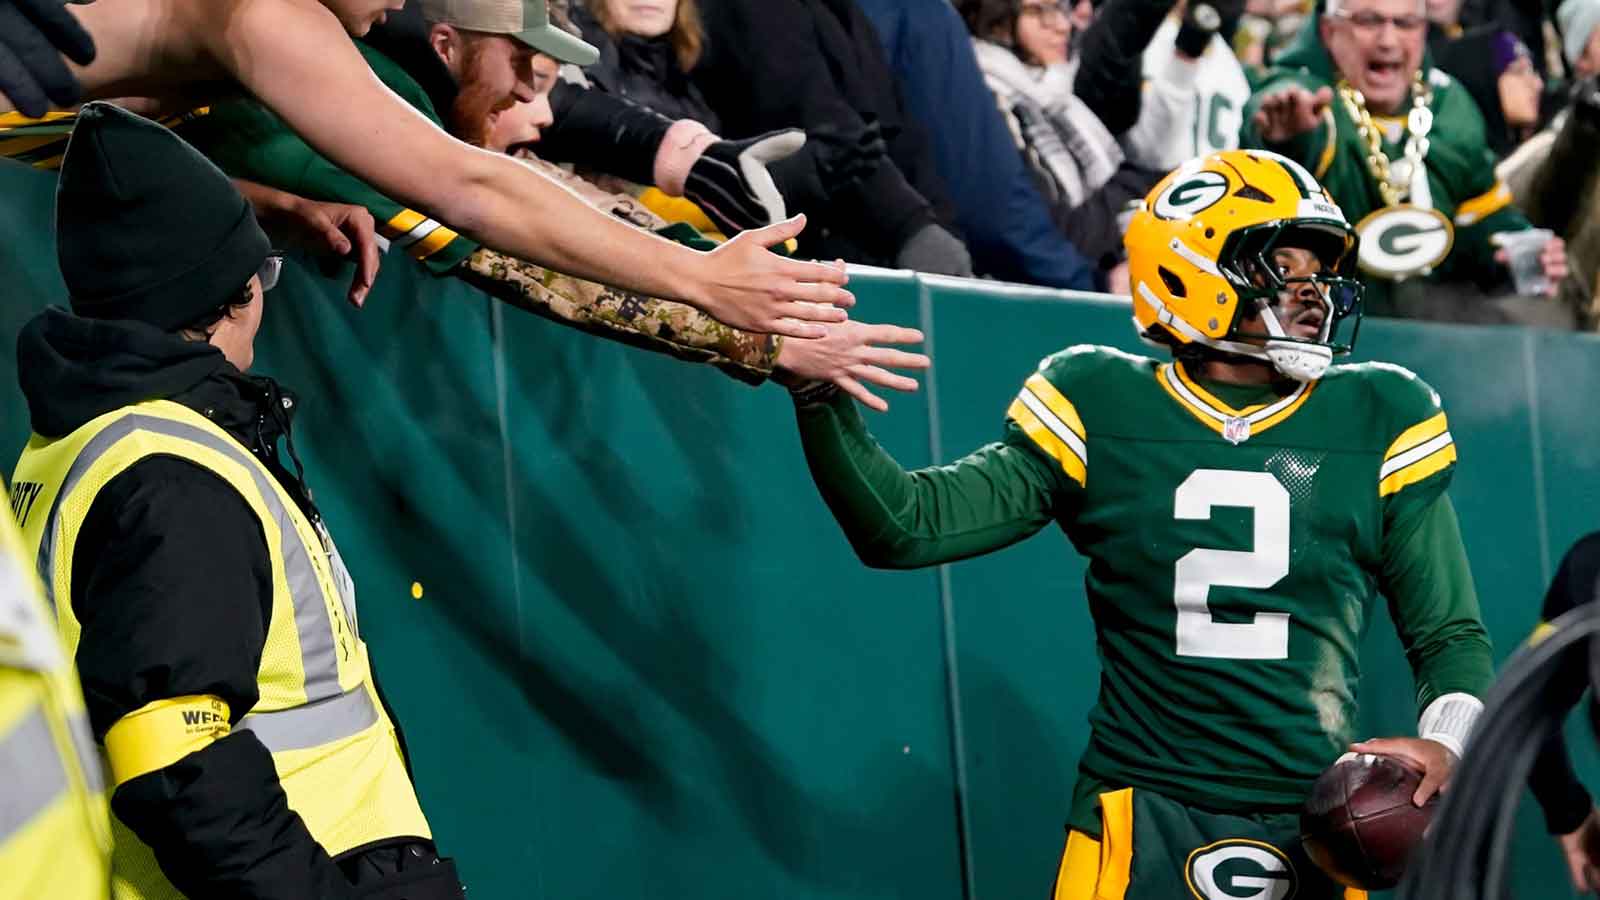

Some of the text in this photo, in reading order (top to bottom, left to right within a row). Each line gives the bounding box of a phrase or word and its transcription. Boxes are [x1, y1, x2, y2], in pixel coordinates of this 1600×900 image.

[1359, 211, 1449, 270] G
[1174, 469, 1291, 659] 2
[1192, 846, 1290, 900] G
